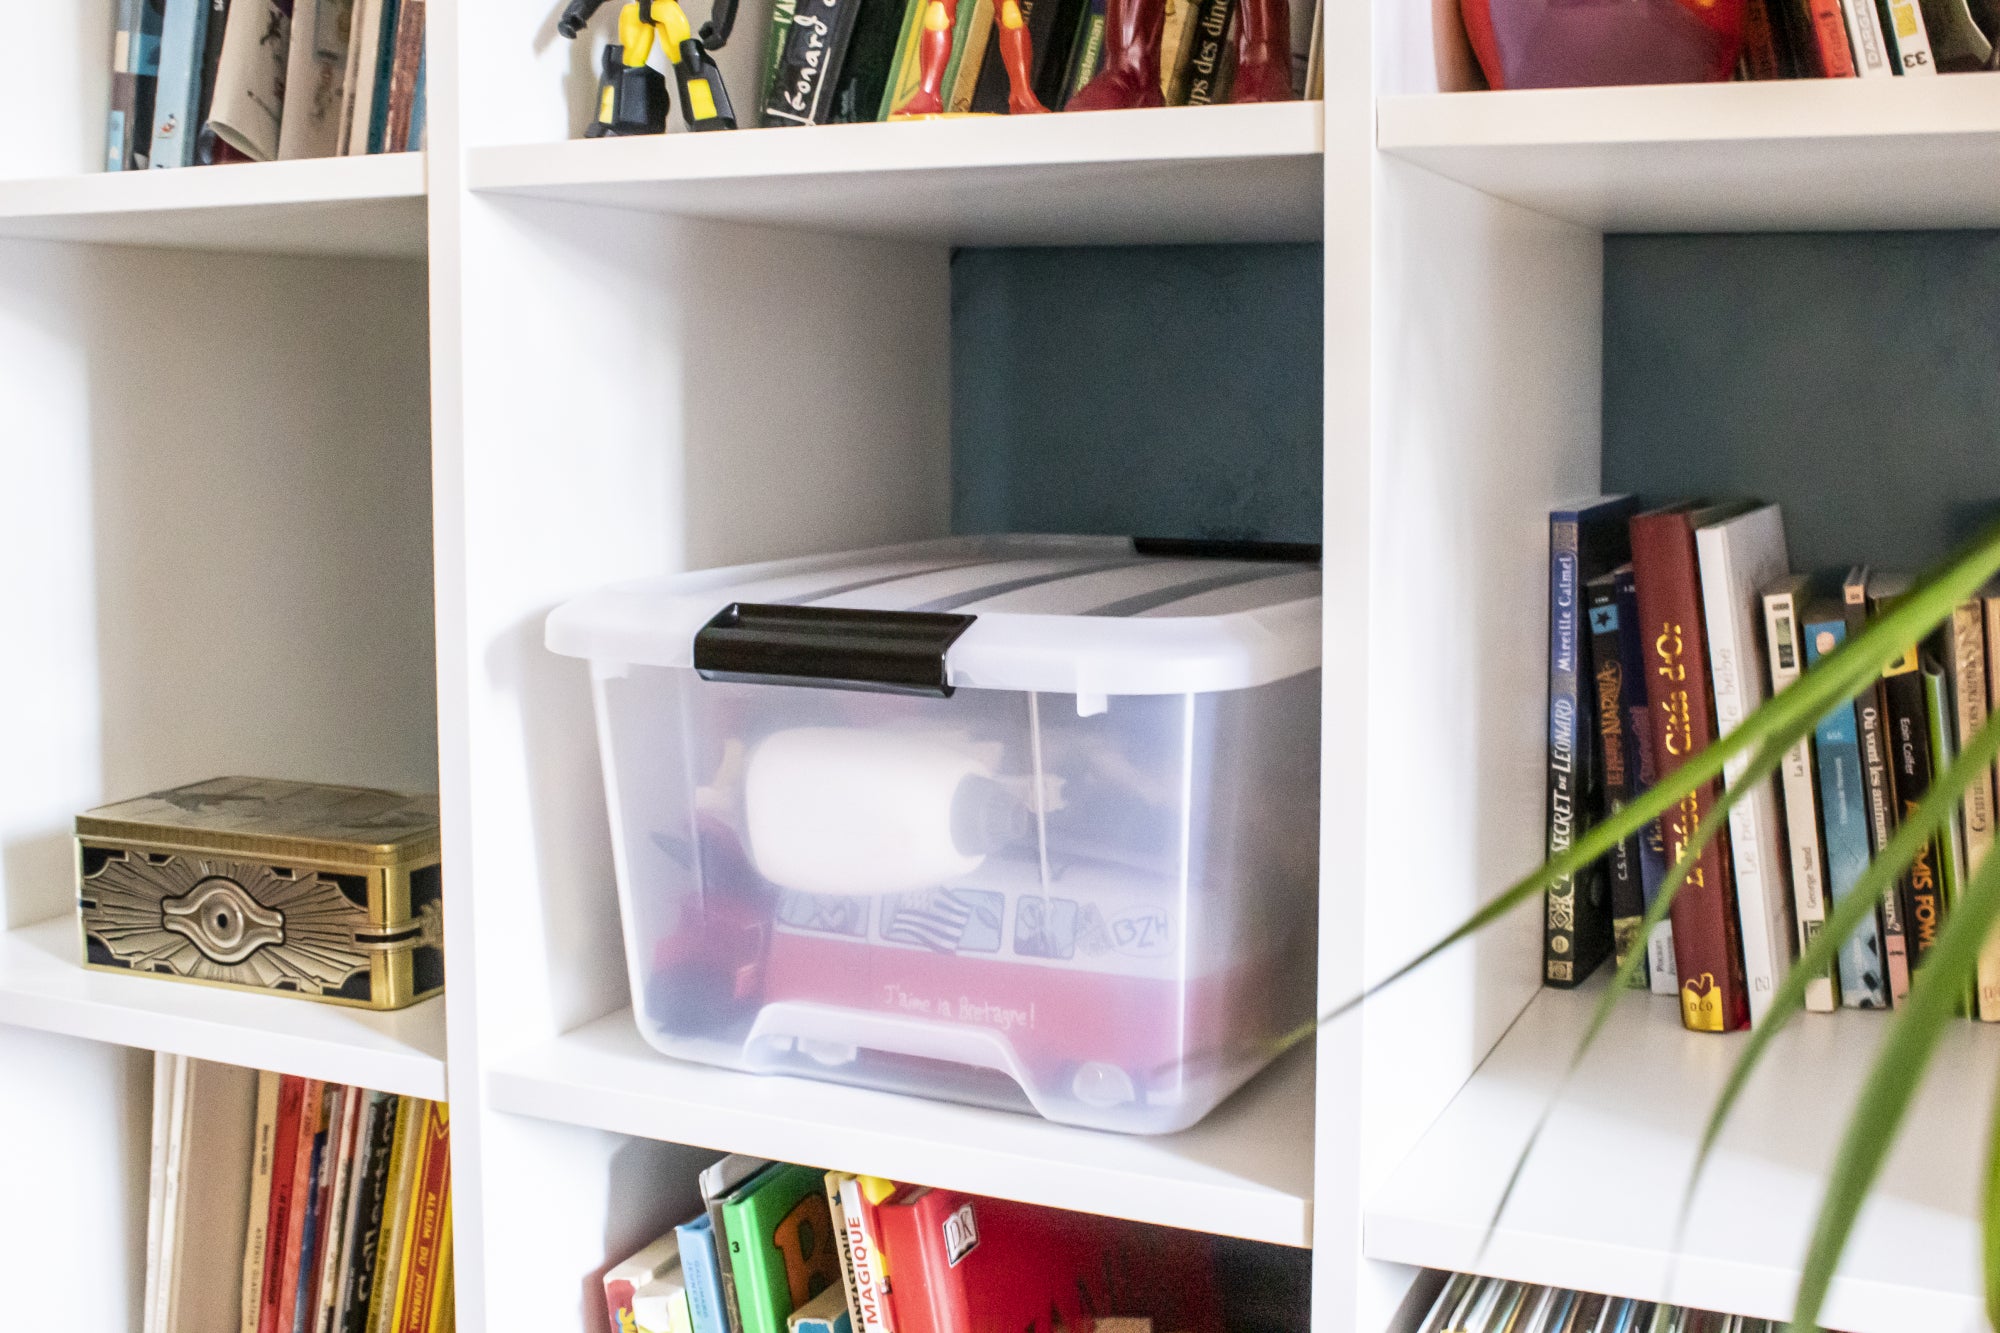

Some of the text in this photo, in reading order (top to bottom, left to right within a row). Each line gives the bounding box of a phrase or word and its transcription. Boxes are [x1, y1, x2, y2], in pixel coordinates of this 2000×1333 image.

[766, 15, 831, 125] Léonard
[1193, 42, 1217, 74] des
[1904, 51, 1927, 68] 33
[1558, 556, 1573, 672] Mireille Calmel
[1866, 733, 1880, 762] vont
[1558, 775, 1568, 791] DE
[1869, 763, 1883, 787] les
[1552, 789, 1574, 852] SECRET
[884, 984, 1035, 1030] J'aime la Bretagne!
[422, 1192, 437, 1238] ALBUM
[949, 1209, 974, 1250] DK
[419, 1246, 430, 1267] DU
[731, 1241, 740, 1253] 3
[840, 1228, 866, 1333] FANTASTIQUE
[848, 1216, 878, 1324] MAGIQUE
